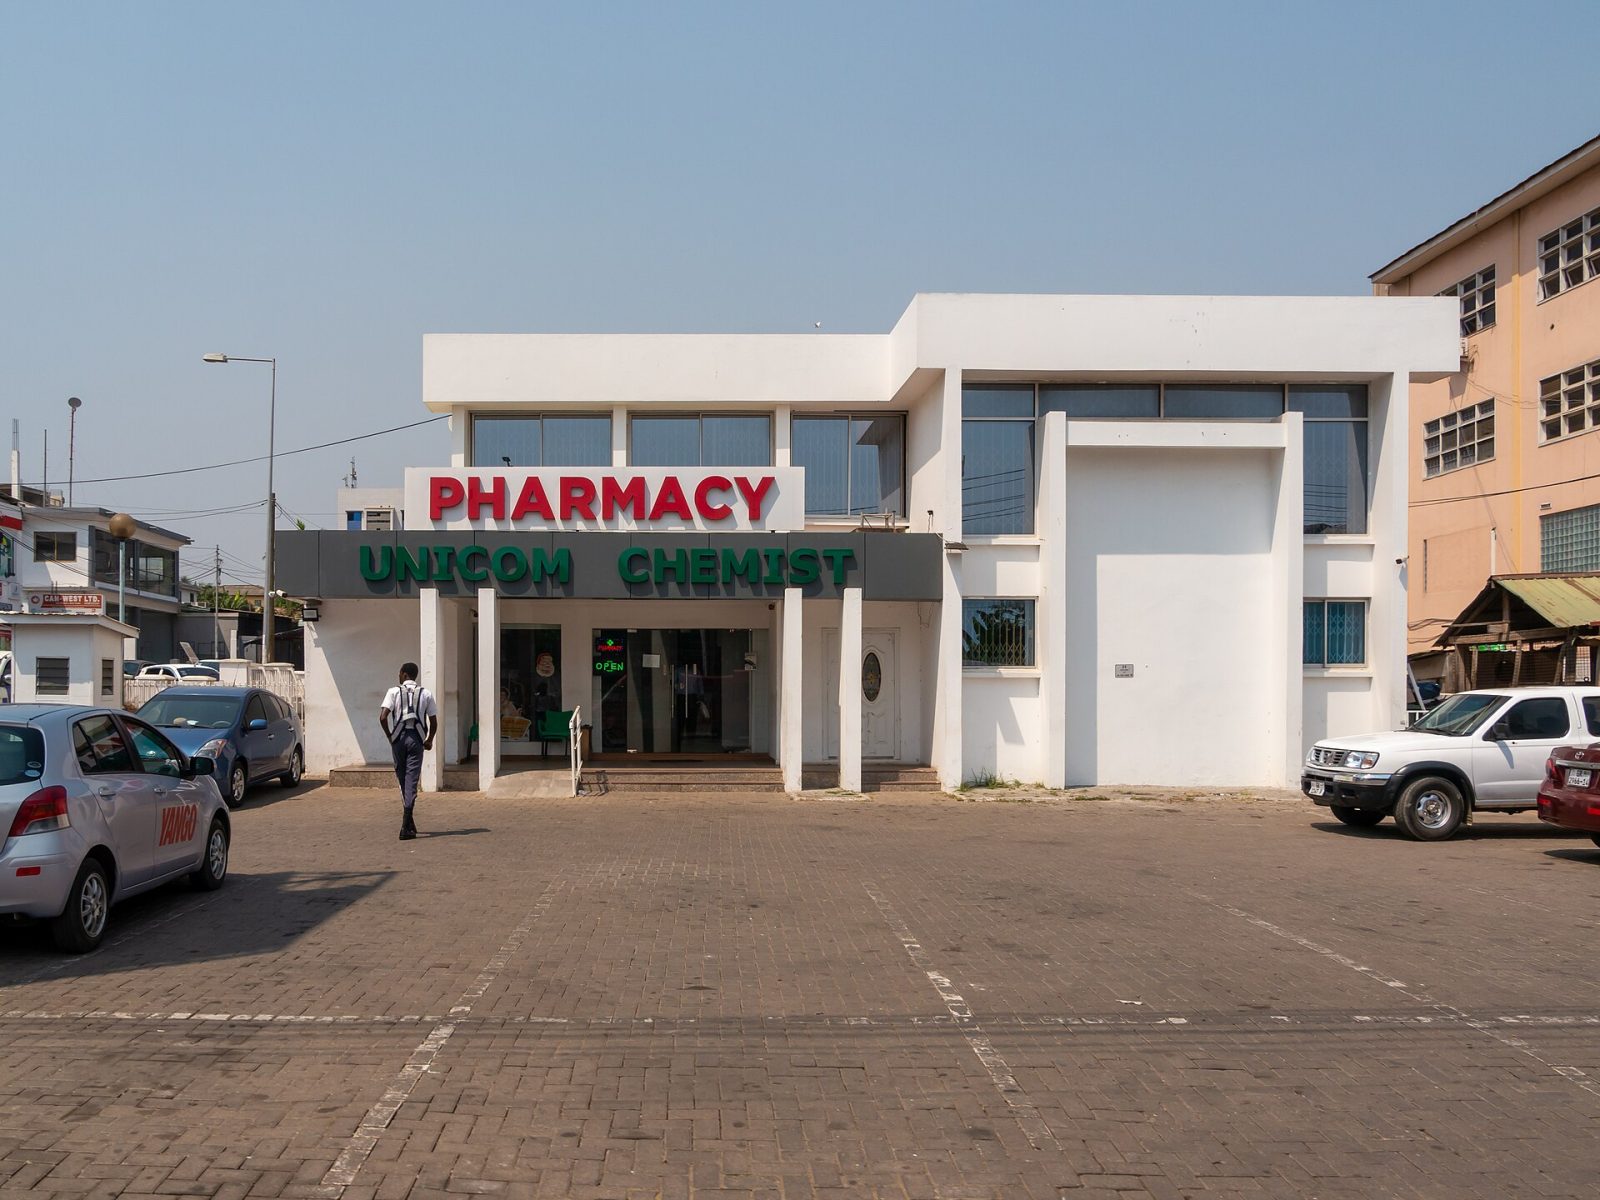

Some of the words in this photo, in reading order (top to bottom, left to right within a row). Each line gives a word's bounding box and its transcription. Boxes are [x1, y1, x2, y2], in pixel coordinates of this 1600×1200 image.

[430, 476, 775, 520] PHARMACY
[360, 546, 570, 583] UNICOM
[618, 547, 854, 585] CHEMIST
[596, 662, 624, 671] OPEN
[159, 804, 197, 847] YANGO
